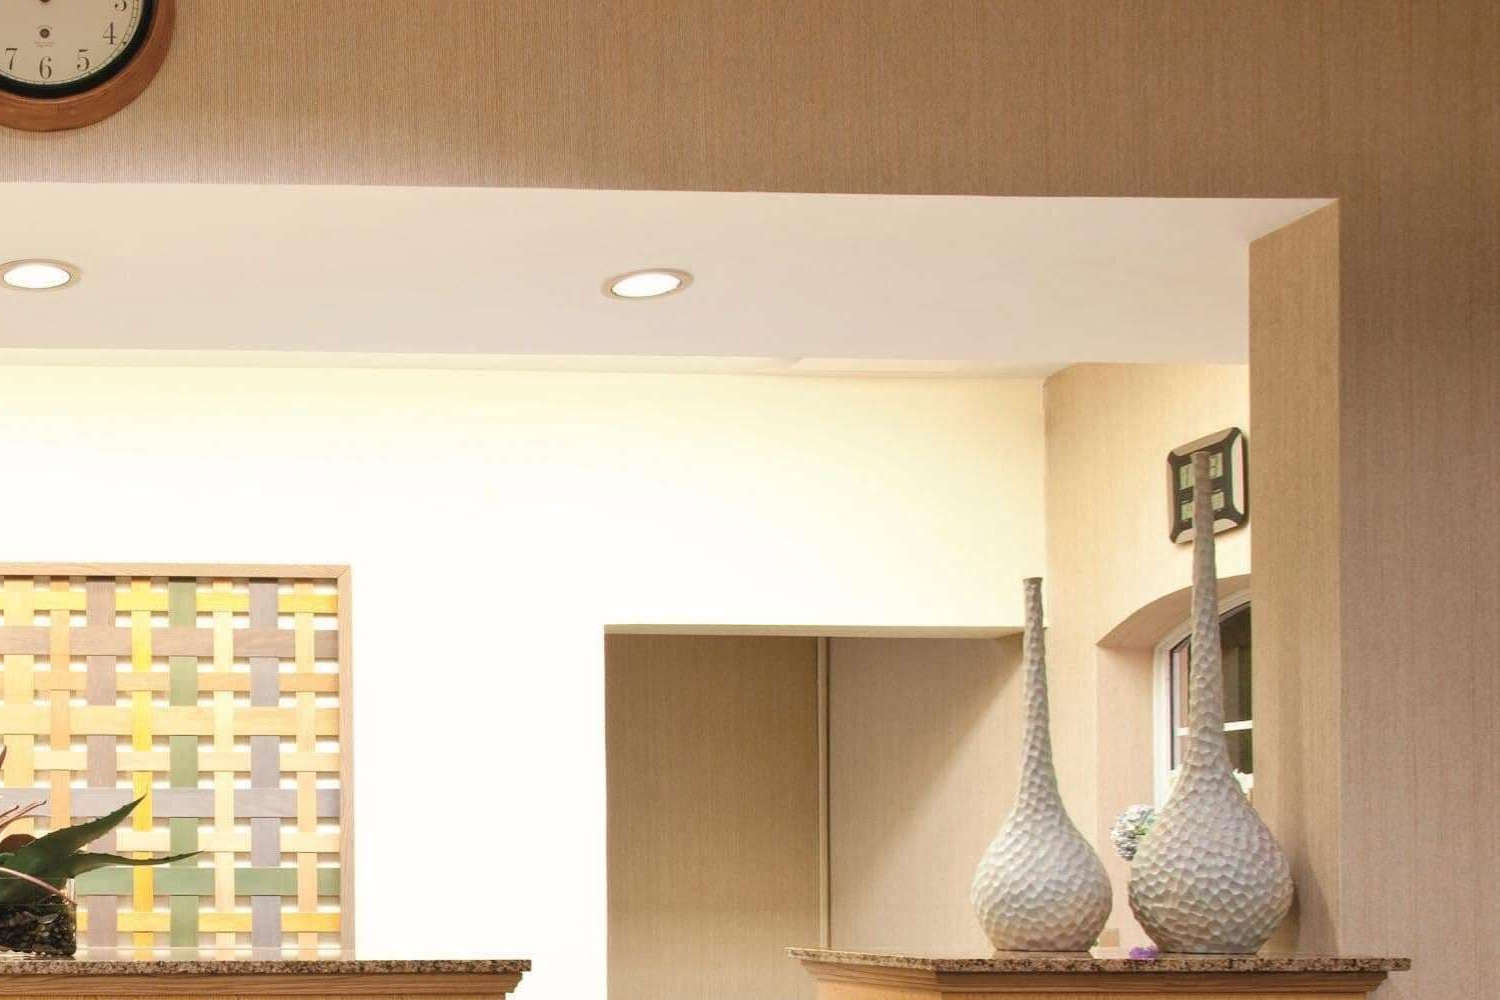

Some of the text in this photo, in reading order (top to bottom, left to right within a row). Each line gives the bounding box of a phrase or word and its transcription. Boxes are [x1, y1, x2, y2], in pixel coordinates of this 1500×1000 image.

[102, 22, 117, 45] 4
[5, 47, 18, 71] 7
[39, 56, 52, 79] 6
[76, 49, 90, 72] 5
